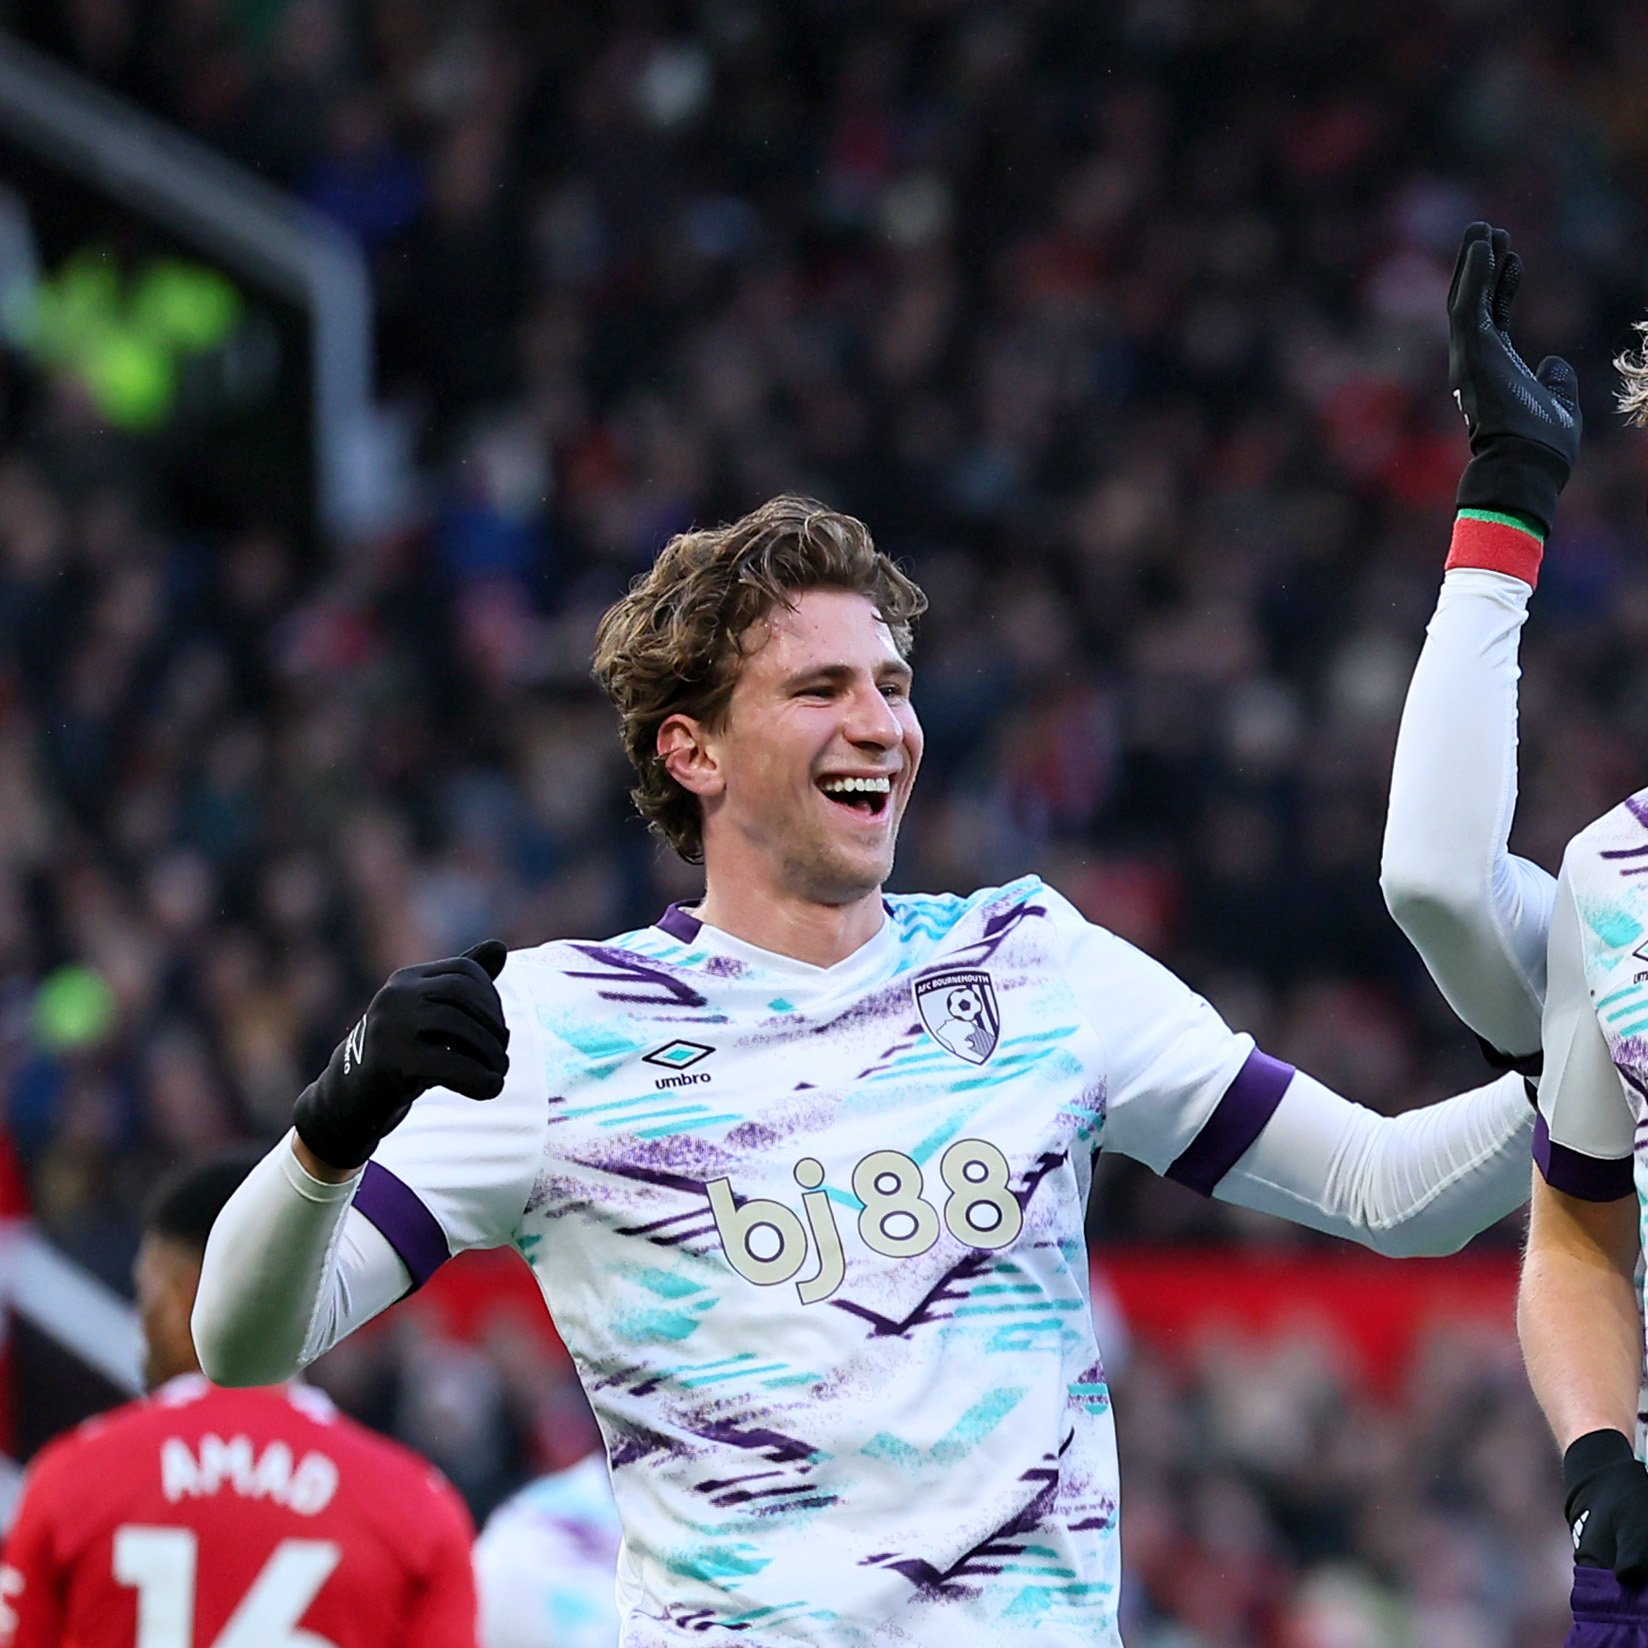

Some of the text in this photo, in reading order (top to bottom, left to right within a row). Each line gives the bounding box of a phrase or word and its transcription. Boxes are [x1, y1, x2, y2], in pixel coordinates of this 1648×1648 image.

[917, 974, 990, 995] AFC BOURNEMOUTH
[655, 1072, 712, 1090] umbro
[706, 1138, 1024, 1305] bj88
[160, 1433, 340, 1516] AMAD
